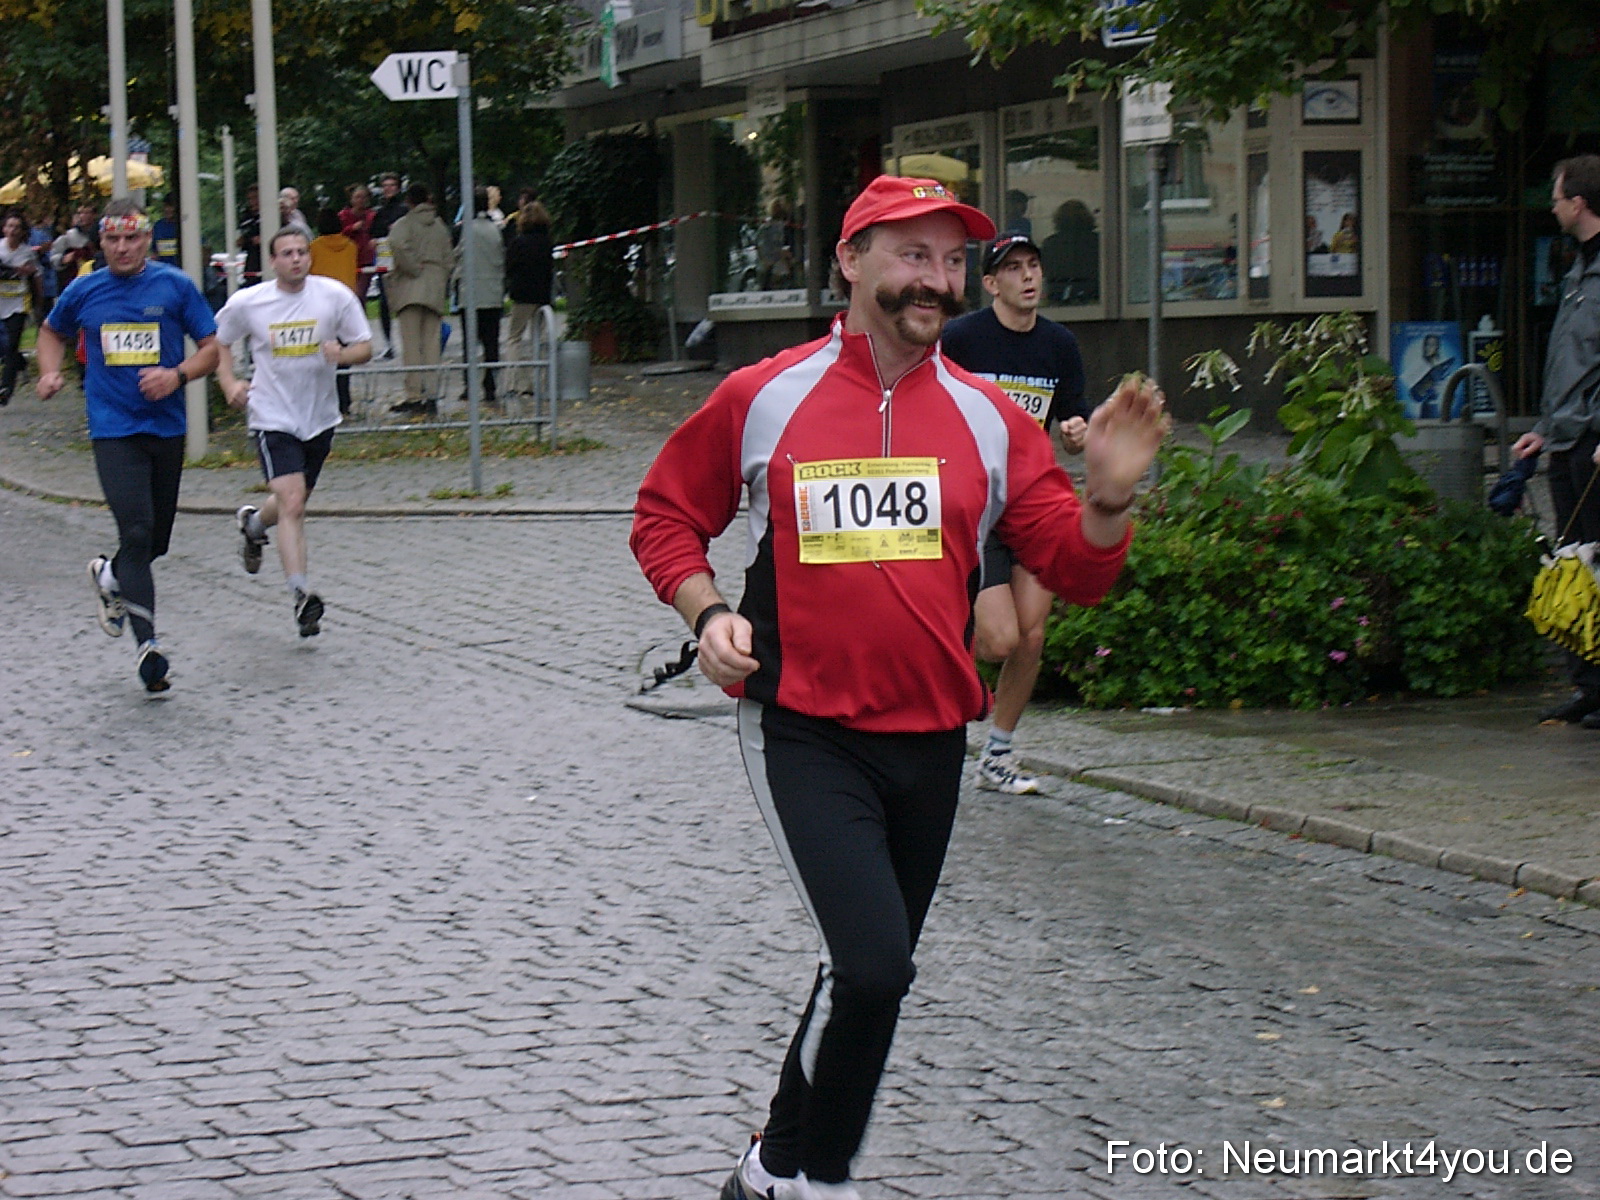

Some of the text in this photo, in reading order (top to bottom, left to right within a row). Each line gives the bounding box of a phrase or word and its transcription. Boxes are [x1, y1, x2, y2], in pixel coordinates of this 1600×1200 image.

[397, 58, 446, 93] WC
[113, 333, 154, 350] 1458
[278, 327, 314, 346] 1477
[1008, 392, 1042, 414] 739
[800, 462, 861, 479] BOCK
[823, 481, 928, 528] 1048
